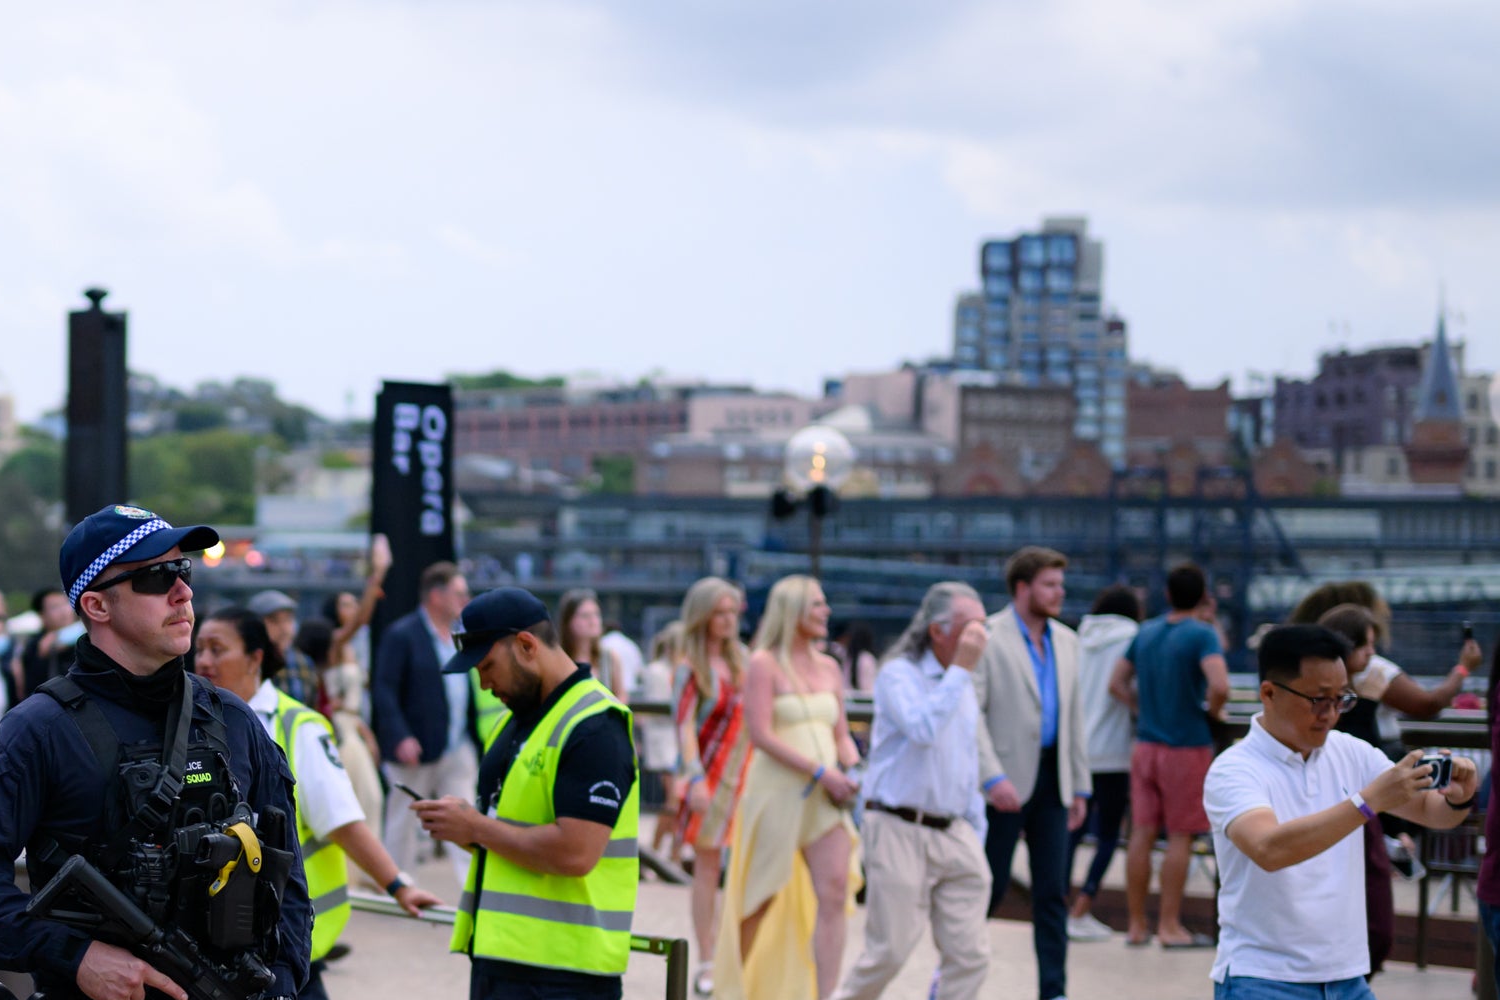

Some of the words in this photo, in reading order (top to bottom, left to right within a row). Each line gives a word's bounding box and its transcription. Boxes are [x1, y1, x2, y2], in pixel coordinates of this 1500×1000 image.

[392, 403, 420, 475] Bar
[417, 404, 447, 535] Opera
[186, 772, 212, 784] SQUAD
